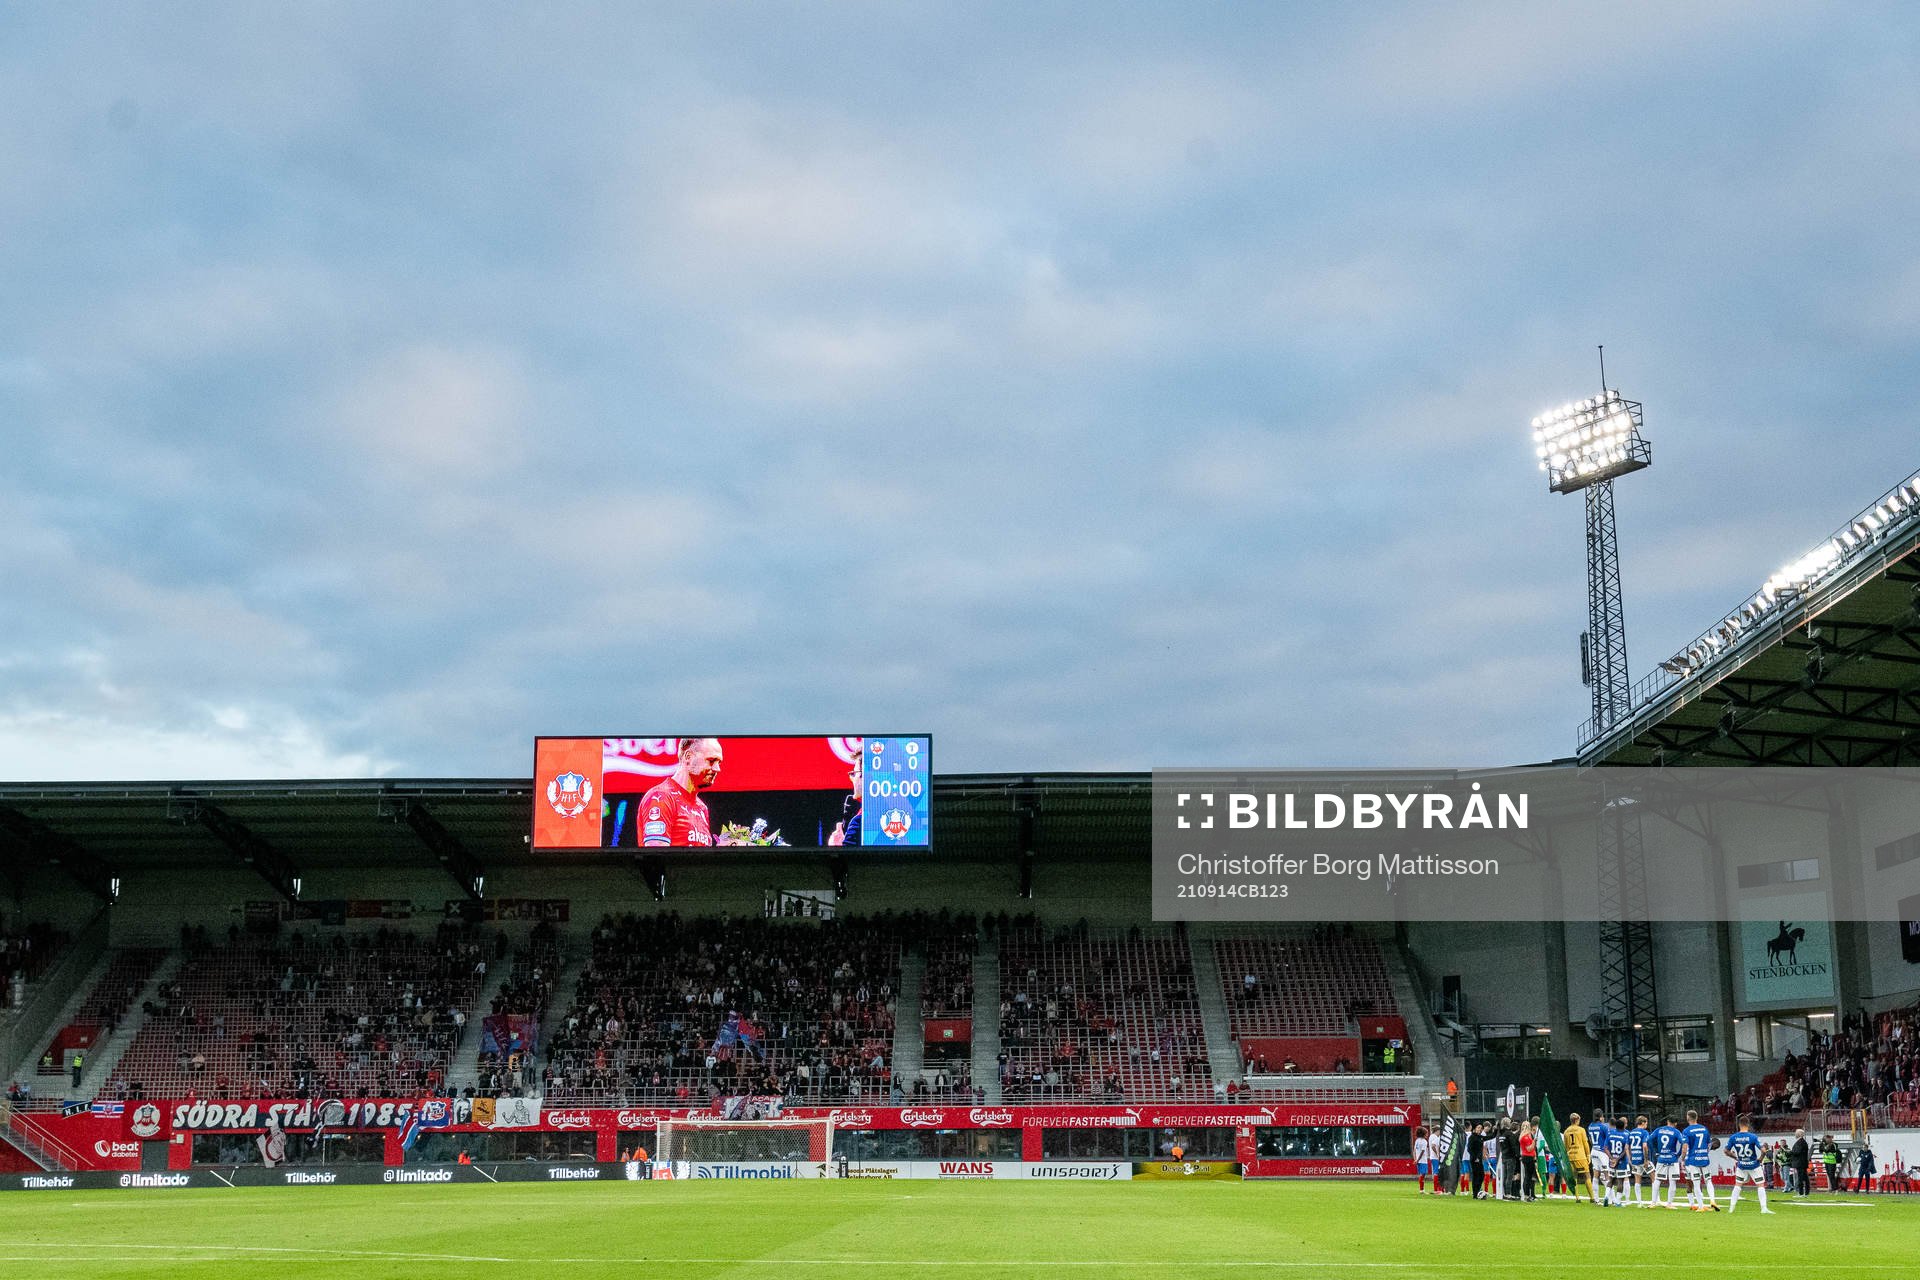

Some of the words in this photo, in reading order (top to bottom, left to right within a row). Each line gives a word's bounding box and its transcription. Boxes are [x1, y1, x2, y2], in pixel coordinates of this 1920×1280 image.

[872, 756, 881, 770] 0
[908, 756, 918, 770] 0
[869, 780, 921, 798] 00:00
[1749, 963, 1827, 980] STENBOCKEN
[172, 1100, 258, 1128] SÖDRA
[548, 1111, 591, 1127] Carlsberg
[617, 1111, 660, 1127] Carlsberg
[830, 1109, 872, 1125] Carlsberg
[900, 1109, 943, 1124] Carlsberg
[969, 1108, 1013, 1124] Carlsberg
[1569, 1133, 1575, 1146] 1
[1589, 1131, 1600, 1145] 17
[1629, 1135, 1642, 1150] 22
[1660, 1134, 1670, 1149] 9
[1695, 1133, 1704, 1149] 7
[112, 1141, 139, 1151] beat
[1609, 1139, 1623, 1155] 18
[1735, 1143, 1753, 1158] 26
[548, 1167, 600, 1179] Tillbehör
[711, 1165, 791, 1179] Tillmobil
[940, 1162, 993, 1174] WANS
[1031, 1166, 1110, 1178] UNISPORT
[21, 1175, 74, 1188] Tillbehör
[132, 1173, 190, 1187] limitado
[285, 1172, 337, 1184] Tillbehör
[396, 1169, 453, 1182] limitado
